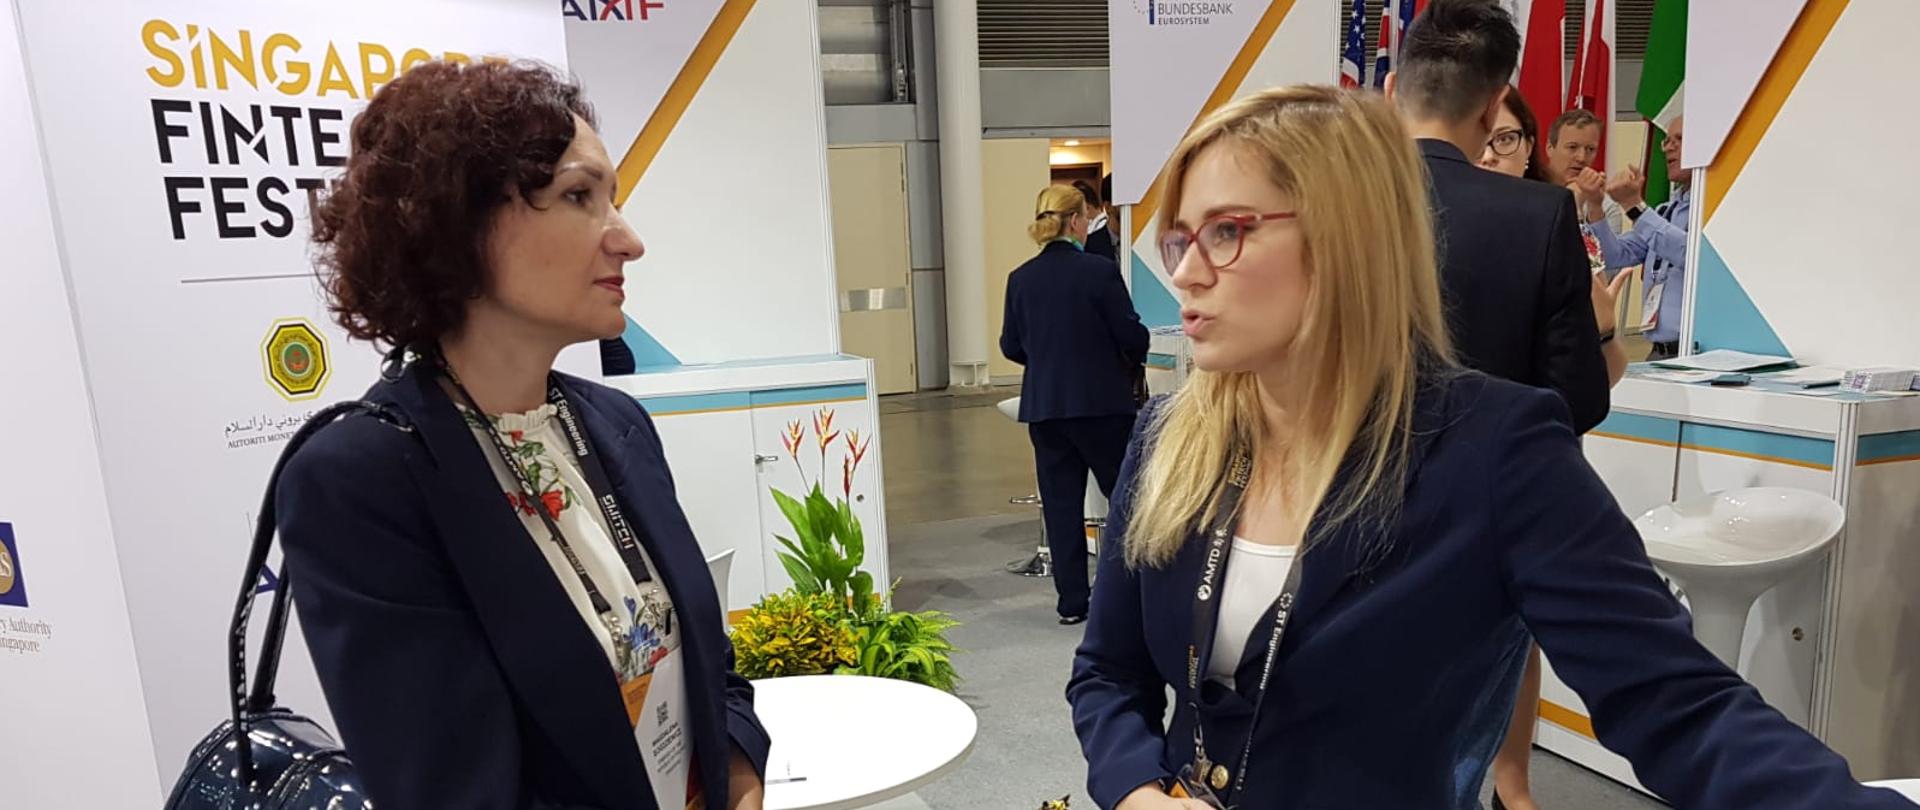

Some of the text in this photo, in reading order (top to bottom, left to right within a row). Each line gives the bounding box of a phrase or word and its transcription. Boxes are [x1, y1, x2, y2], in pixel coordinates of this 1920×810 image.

[1158, 2, 1233, 15] BUNDESBANK
[1158, 17, 1210, 25] EUROSYSTEM
[141, 19, 509, 100] SINGAP
[164, 176, 337, 241] FEST
[549, 387, 589, 457] ST Engineering
[228, 435, 265, 449] AUTORITI
[1203, 548, 1221, 585] AMTD
[9, 616, 52, 639] Authority
[1259, 610, 1287, 690] ST Engineering
